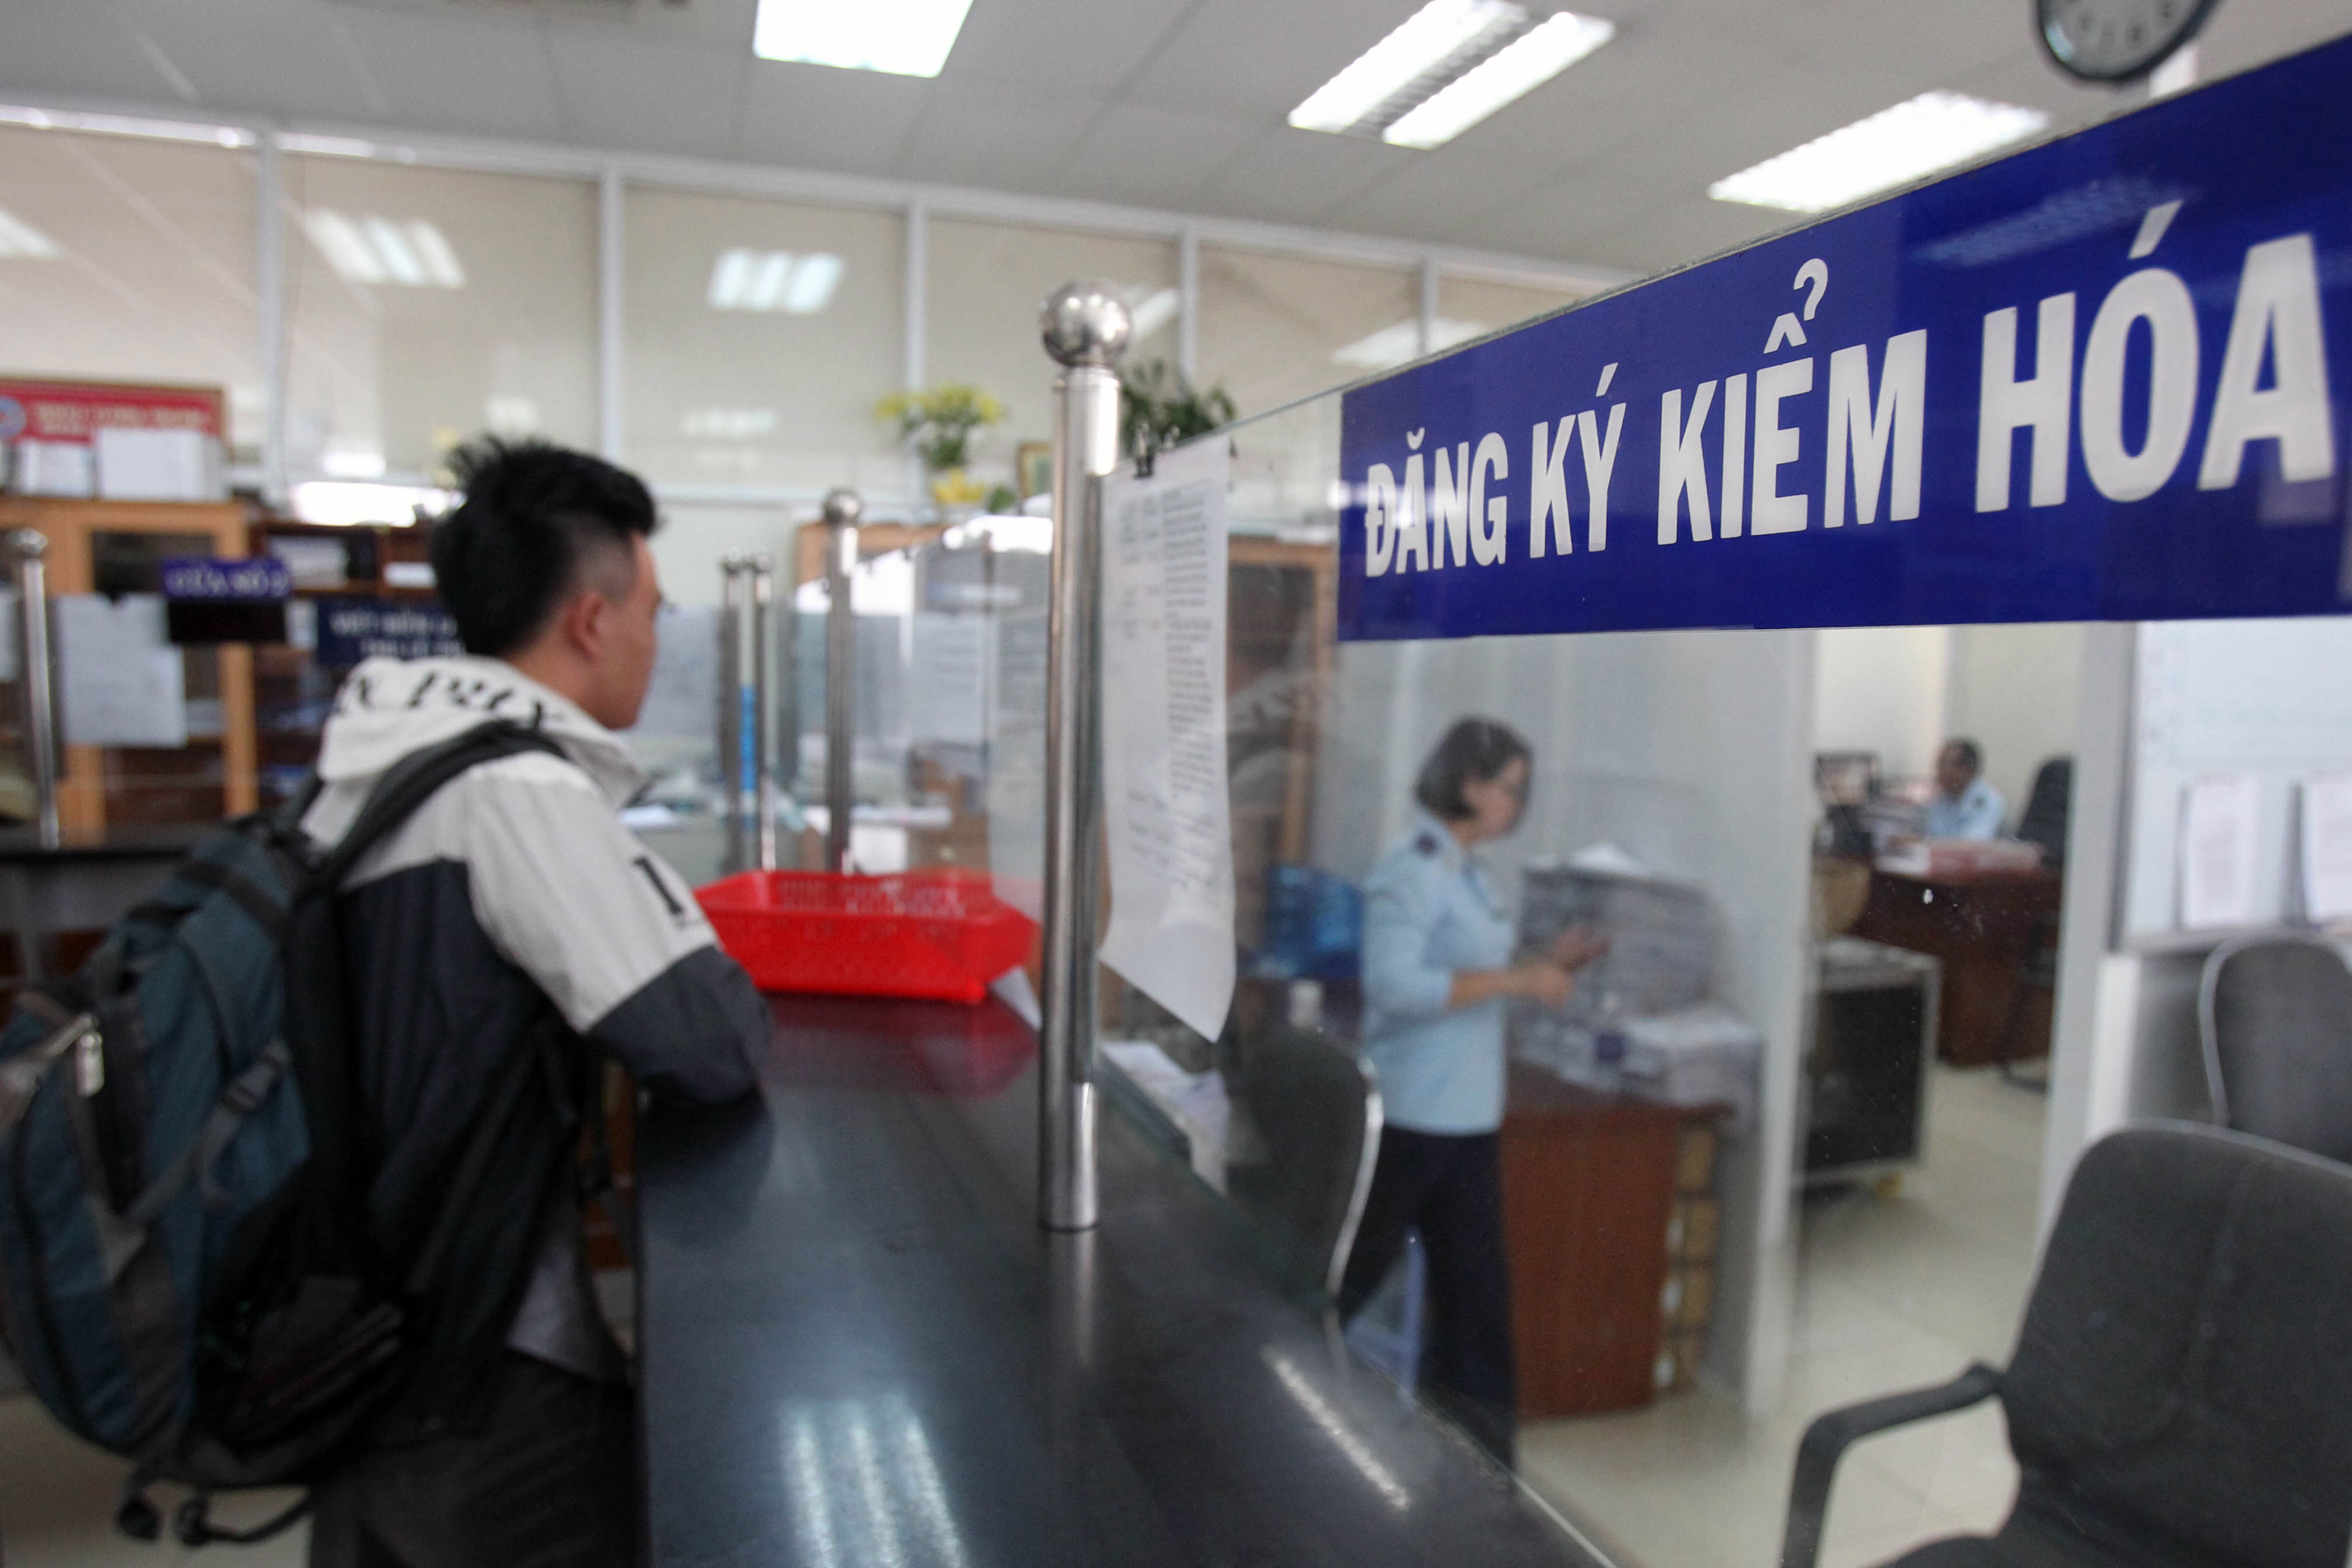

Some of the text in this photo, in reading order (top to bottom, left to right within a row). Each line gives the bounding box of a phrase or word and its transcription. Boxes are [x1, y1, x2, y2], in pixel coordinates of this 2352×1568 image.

[1365, 202, 2334, 577] ĐĂNG KÝ KIỂM HÓA
